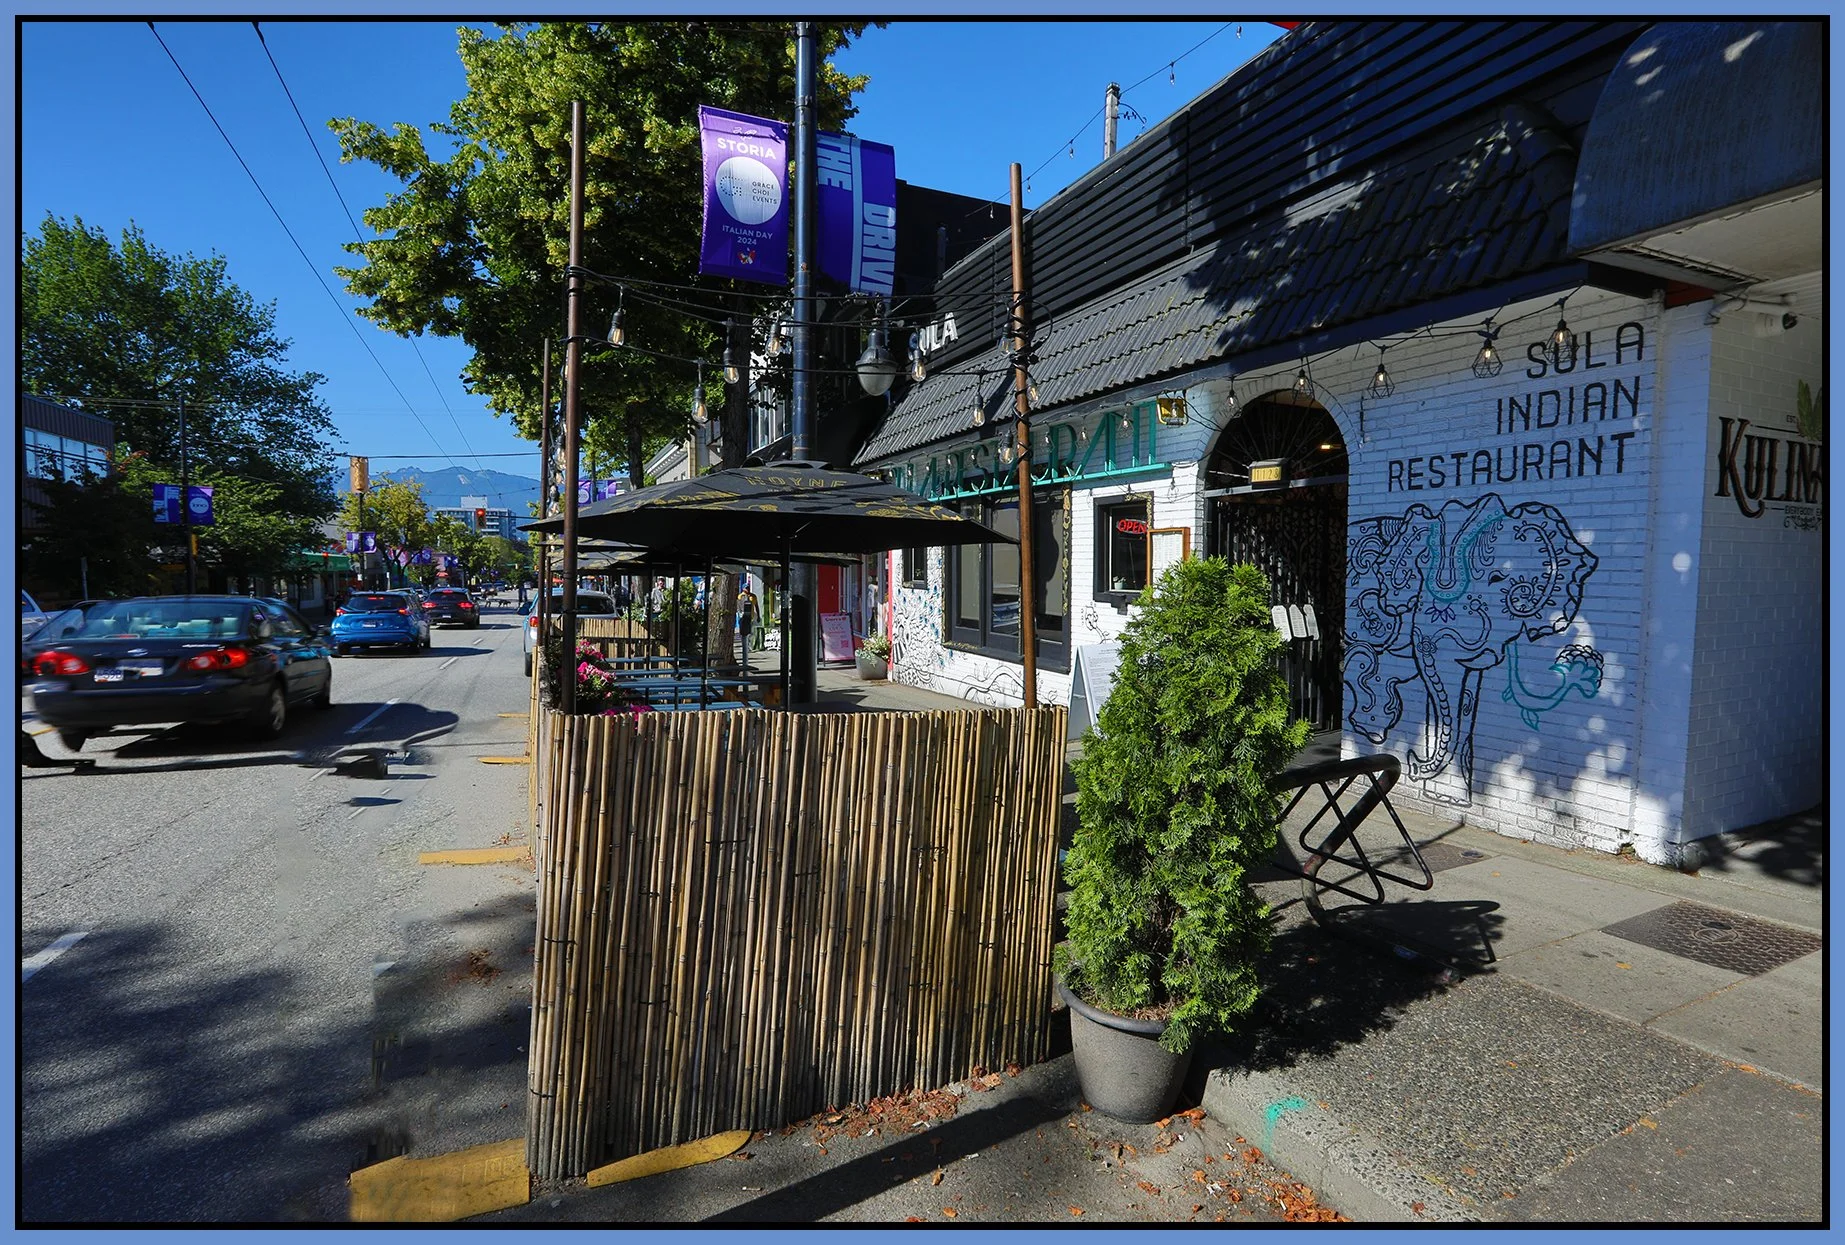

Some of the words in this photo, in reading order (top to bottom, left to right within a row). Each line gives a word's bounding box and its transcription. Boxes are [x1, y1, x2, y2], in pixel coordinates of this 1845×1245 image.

[717, 138, 776, 159] STORIA
[752, 181, 774, 189] GRACE
[752, 188, 770, 196] CHOI
[752, 196, 777, 205] EVENTS
[722, 225, 754, 237] ITALIAN
[756, 231, 773, 240] DAY
[737, 236, 757, 245] 2024
[909, 312, 958, 358] ULA
[1527, 321, 1644, 379] SULA
[1497, 376, 1640, 435] INDIAN
[1388, 432, 1635, 493] RESTAURANT
[1714, 416, 1822, 519] KULIN
[1117, 518, 1148, 534] OPEN
